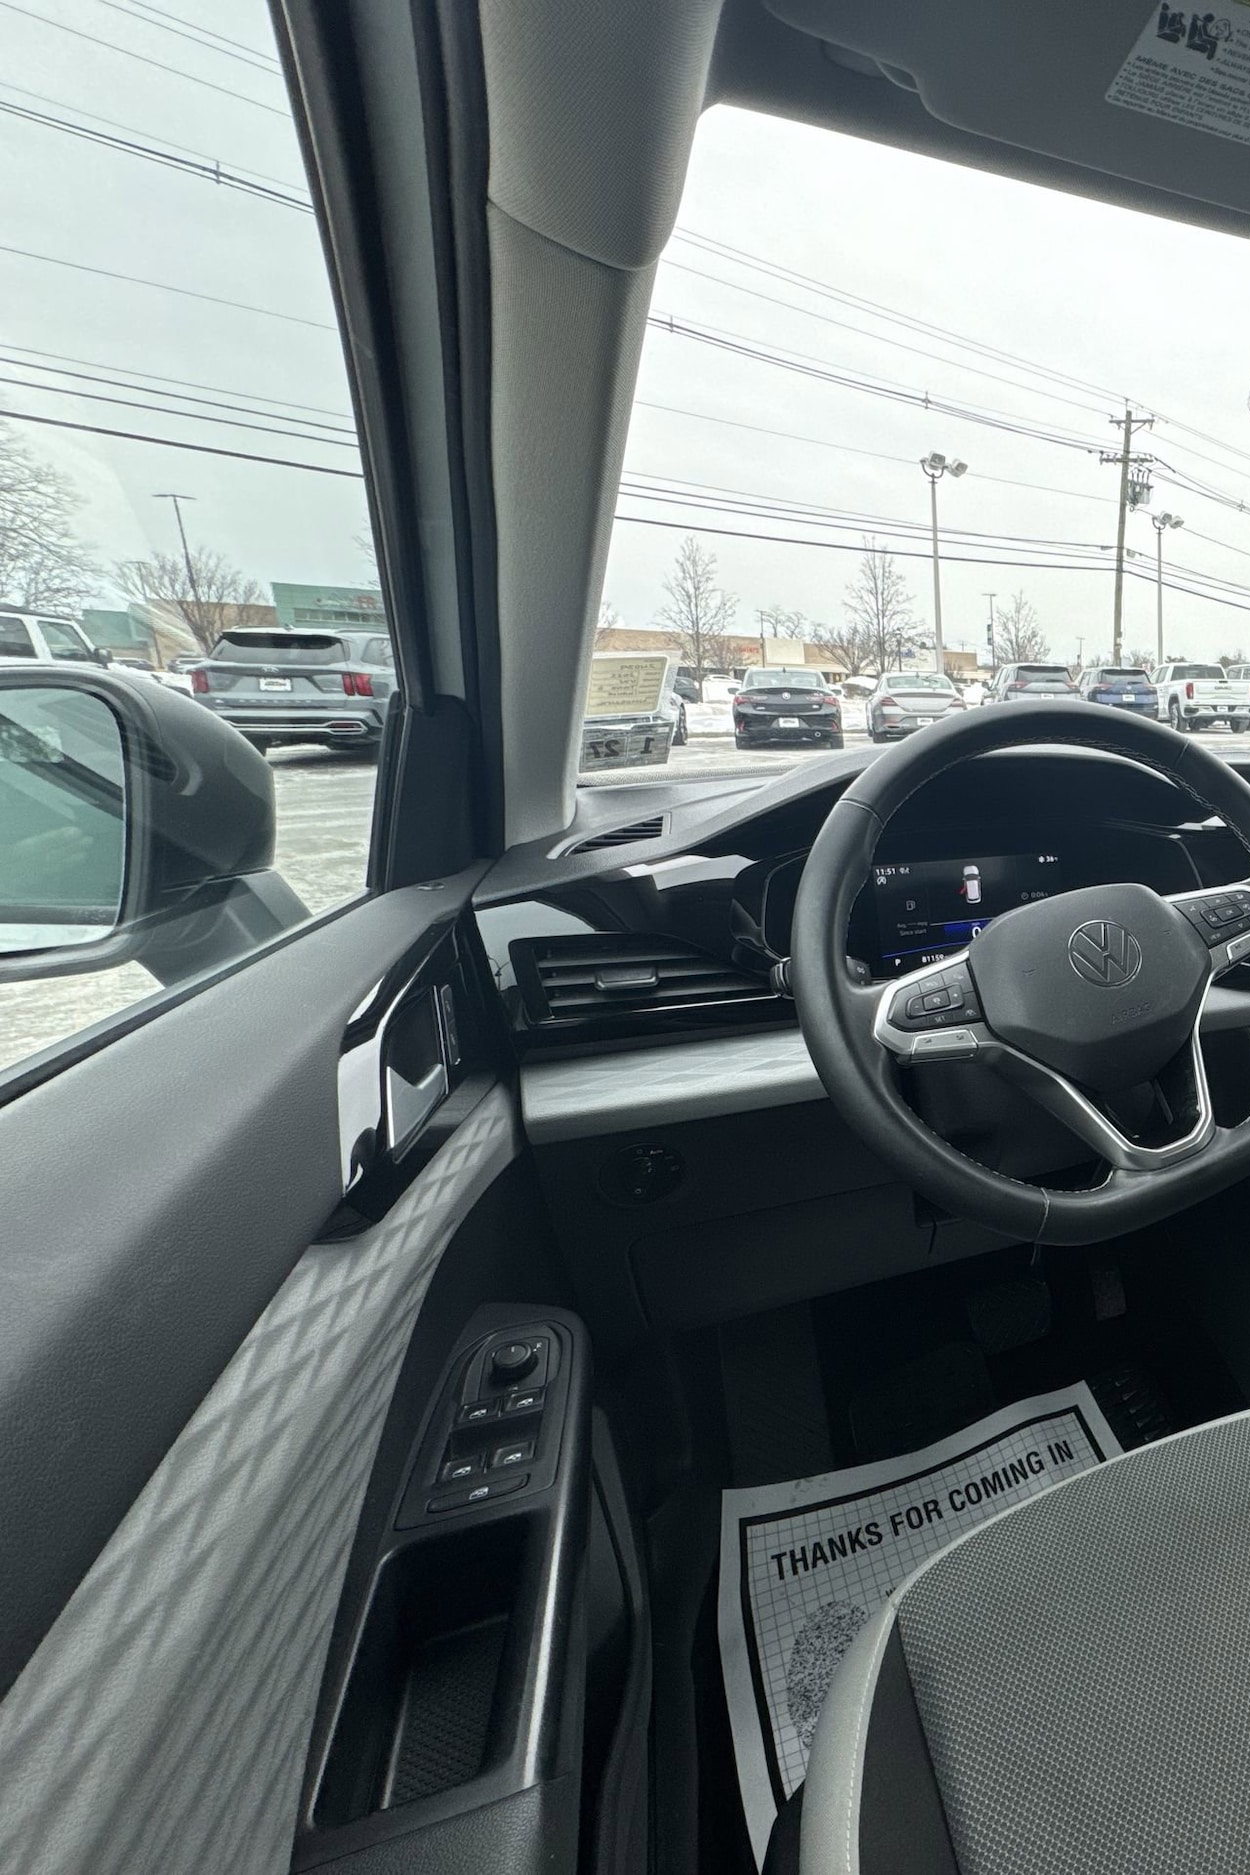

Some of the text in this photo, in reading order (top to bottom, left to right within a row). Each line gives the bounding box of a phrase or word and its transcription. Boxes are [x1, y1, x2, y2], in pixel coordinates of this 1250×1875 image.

[1169, 65, 1198, 79] AVEC
[1197, 75, 1219, 87] DES
[875, 867, 896, 876] 11:51
[895, 959, 902, 967] P
[921, 954, 944, 964] 81159
[771, 1440, 1075, 1580] THANKS FOR COMING IN
